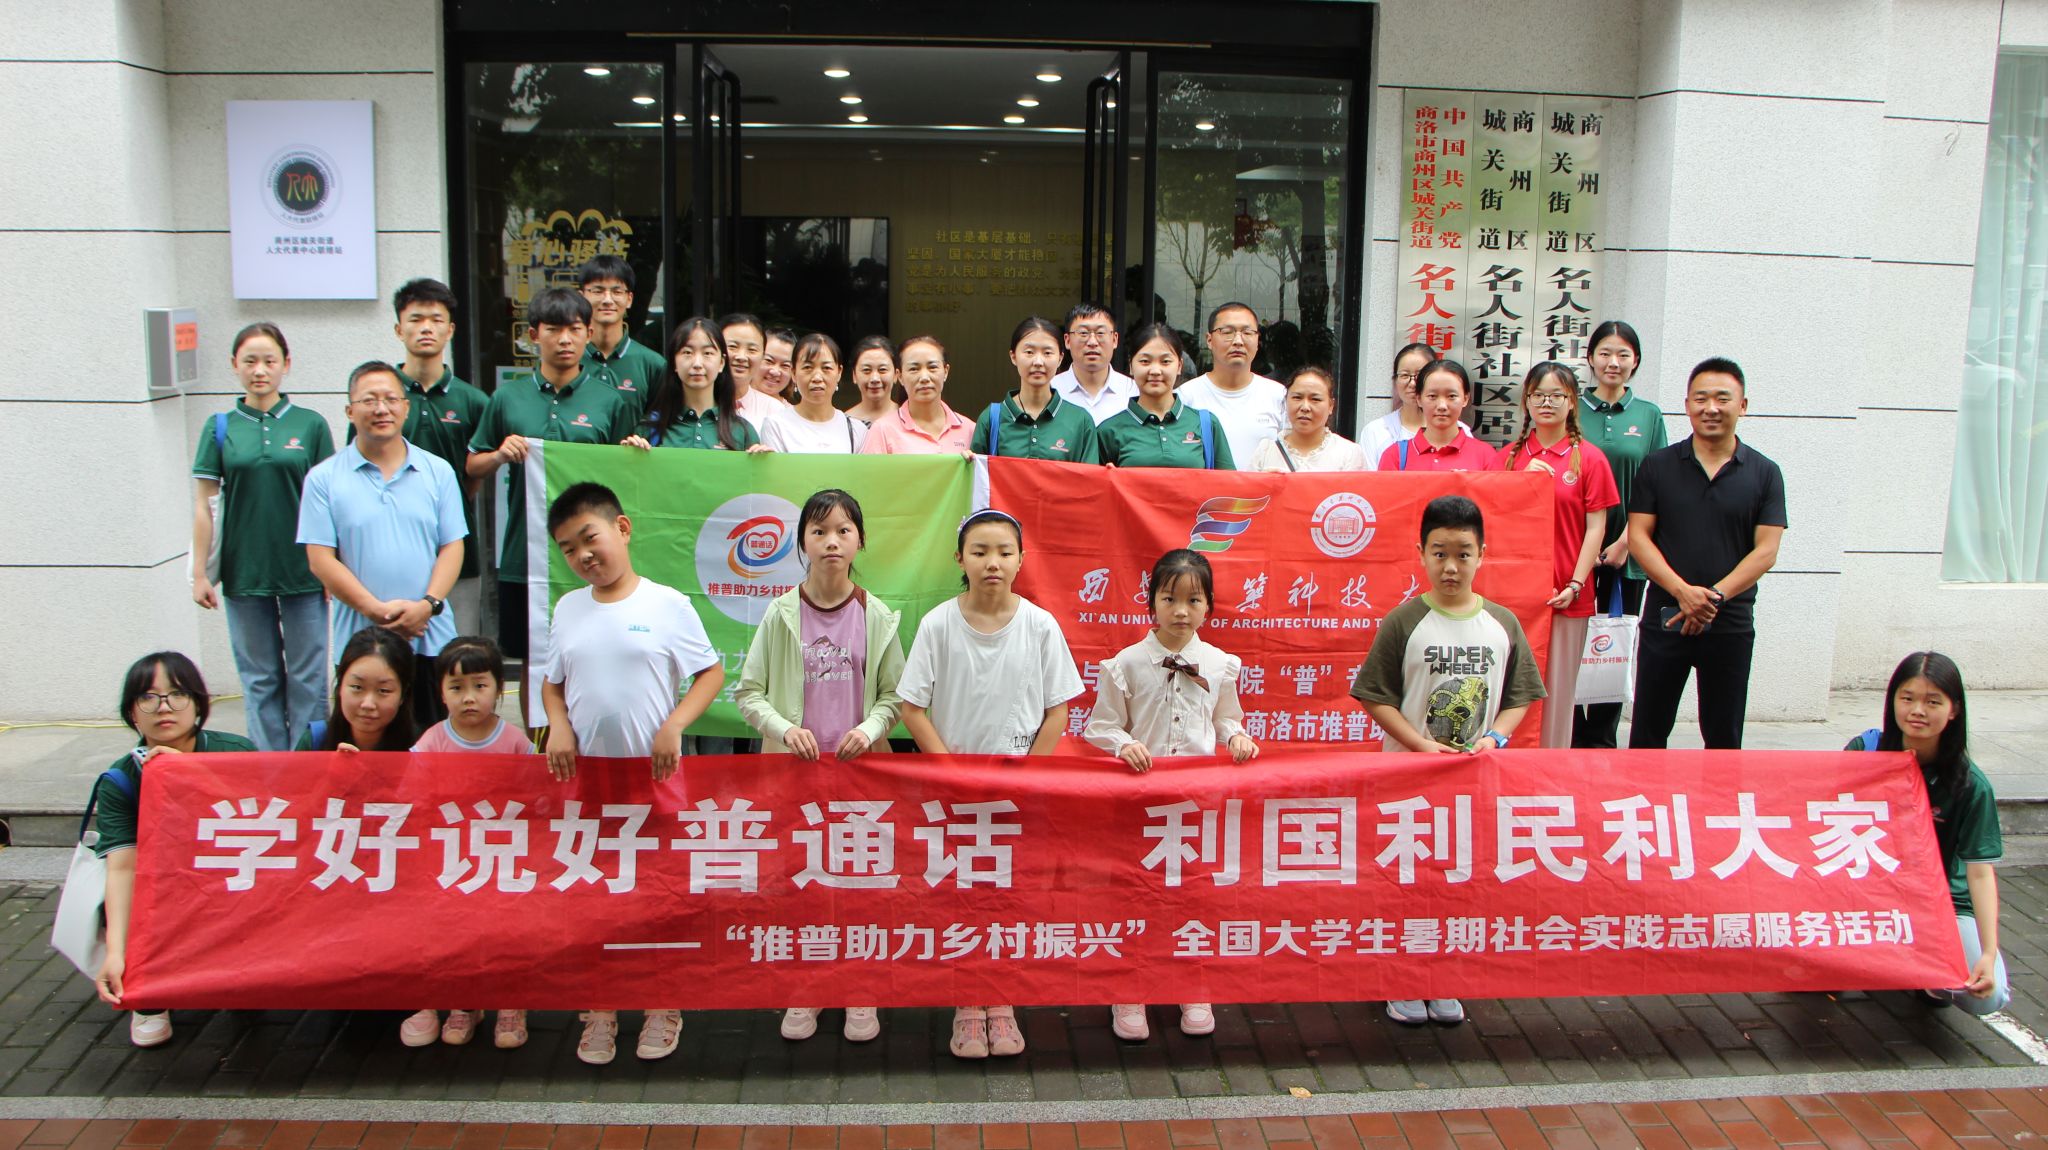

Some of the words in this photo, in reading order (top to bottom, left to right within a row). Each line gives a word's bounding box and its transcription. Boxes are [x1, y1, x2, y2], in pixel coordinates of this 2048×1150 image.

[1409, 105, 1438, 249] 商洛市商州区城关街道
[1438, 107, 1466, 249] 中国共产党
[1477, 108, 1506, 250] 城关街道
[1507, 110, 1536, 250] 商州区
[1545, 111, 1574, 253] 城关街道
[1574, 113, 1603, 253] 商州区
[1405, 263, 1456, 360] 名人街
[1210, 618, 1229, 629] OF
[1232, 617, 1338, 629] ARCHITECTURE
[1342, 618, 1371, 629] AND
[1424, 646, 1495, 666] SUPER
[1430, 663, 1489, 676] WHEELS
[195, 795, 1022, 894] 学好说好普通话
[1140, 792, 1900, 888] 利国利民利大家
